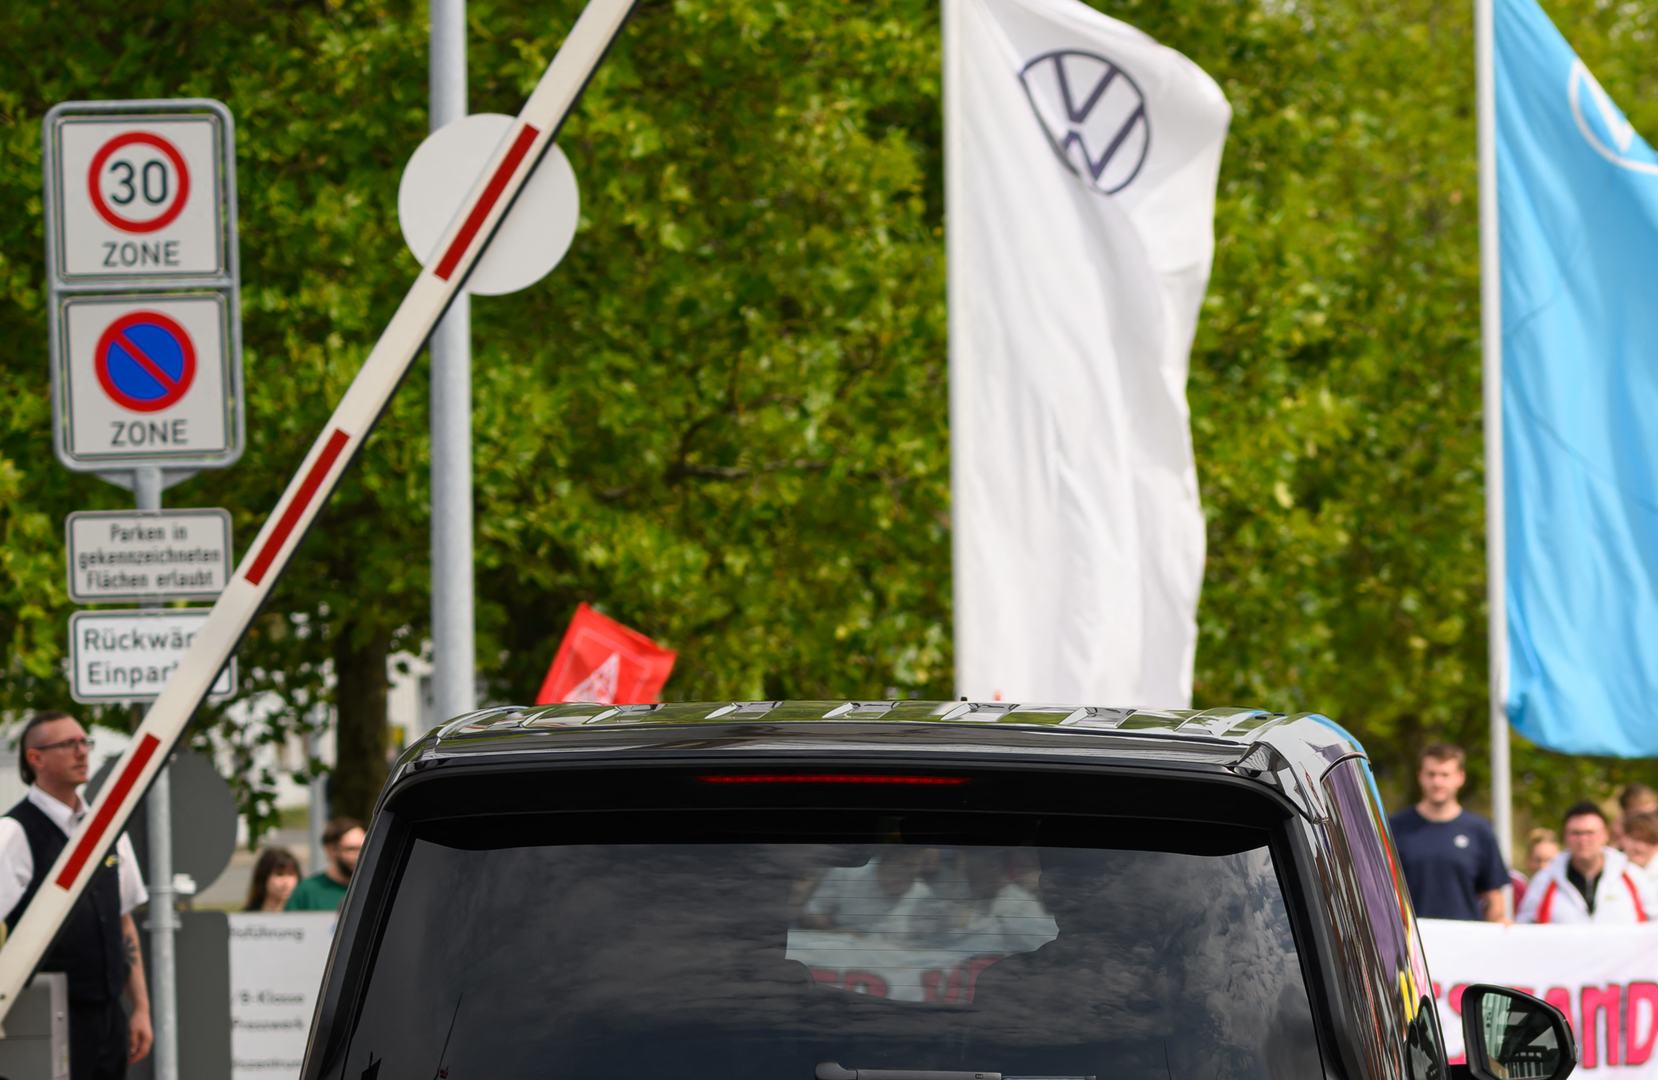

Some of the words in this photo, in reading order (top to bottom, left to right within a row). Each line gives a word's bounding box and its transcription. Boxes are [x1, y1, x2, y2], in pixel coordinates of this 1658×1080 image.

[109, 160, 168, 205] 30
[102, 242, 180, 267] ZONE
[110, 421, 188, 446] ZONE
[109, 524, 165, 542] Parken
[172, 524, 188, 540] in
[79, 549, 221, 570] gekennzeichneten
[86, 571, 149, 589] Flächen
[156, 571, 213, 587] erlaubt
[83, 627, 196, 651] Rückwär
[87, 660, 178, 688] Einpar
